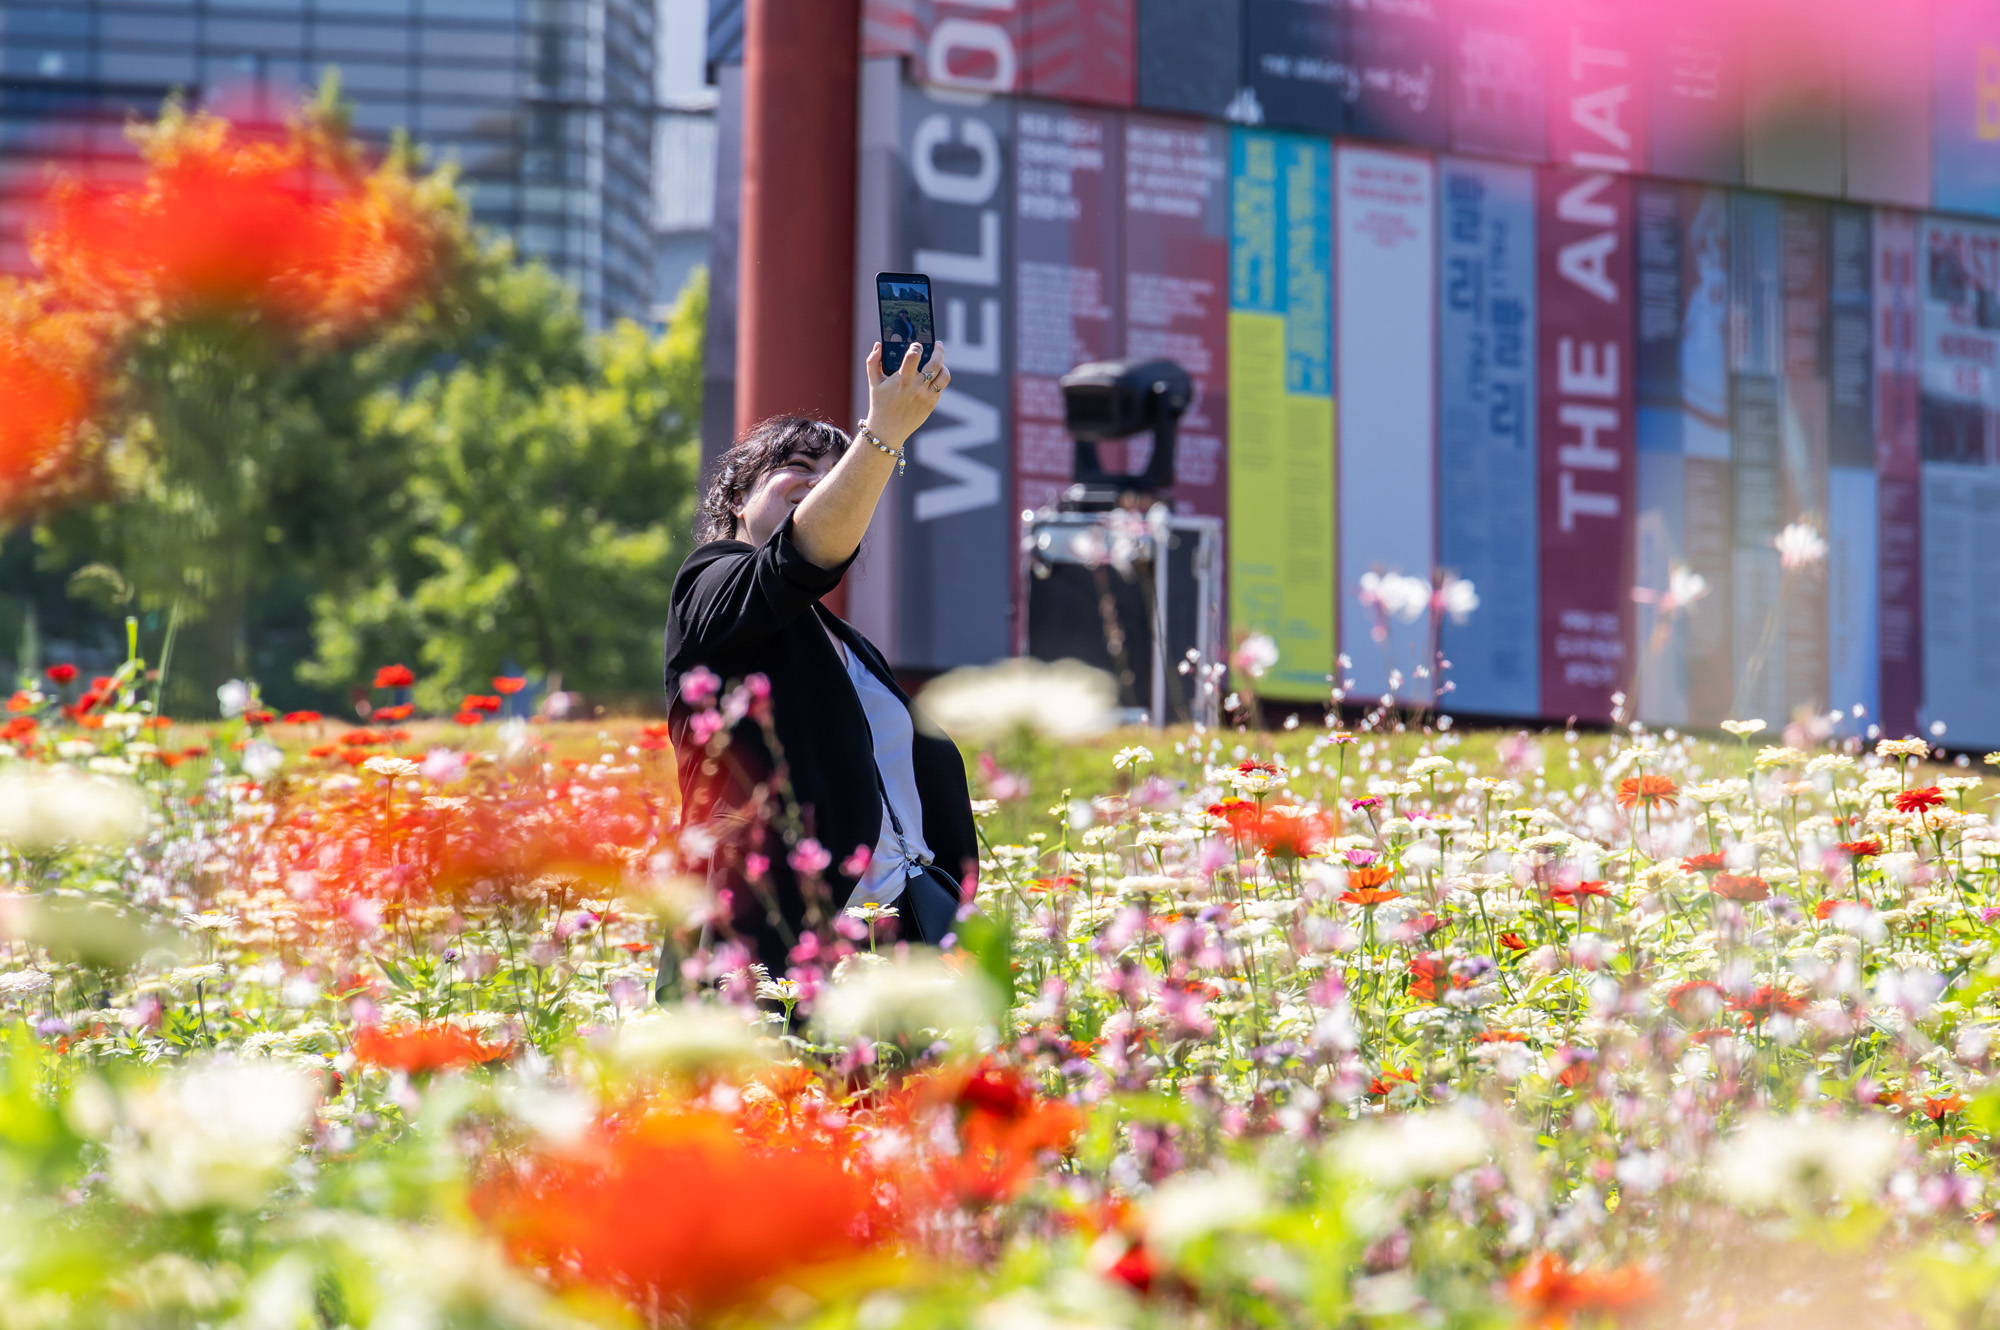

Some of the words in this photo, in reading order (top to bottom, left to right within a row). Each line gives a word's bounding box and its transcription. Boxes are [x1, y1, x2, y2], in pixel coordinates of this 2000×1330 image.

[913, 0, 1016, 522] WELCO
[1557, 0, 1631, 302] ANAT
[1557, 342, 1620, 533] THE
